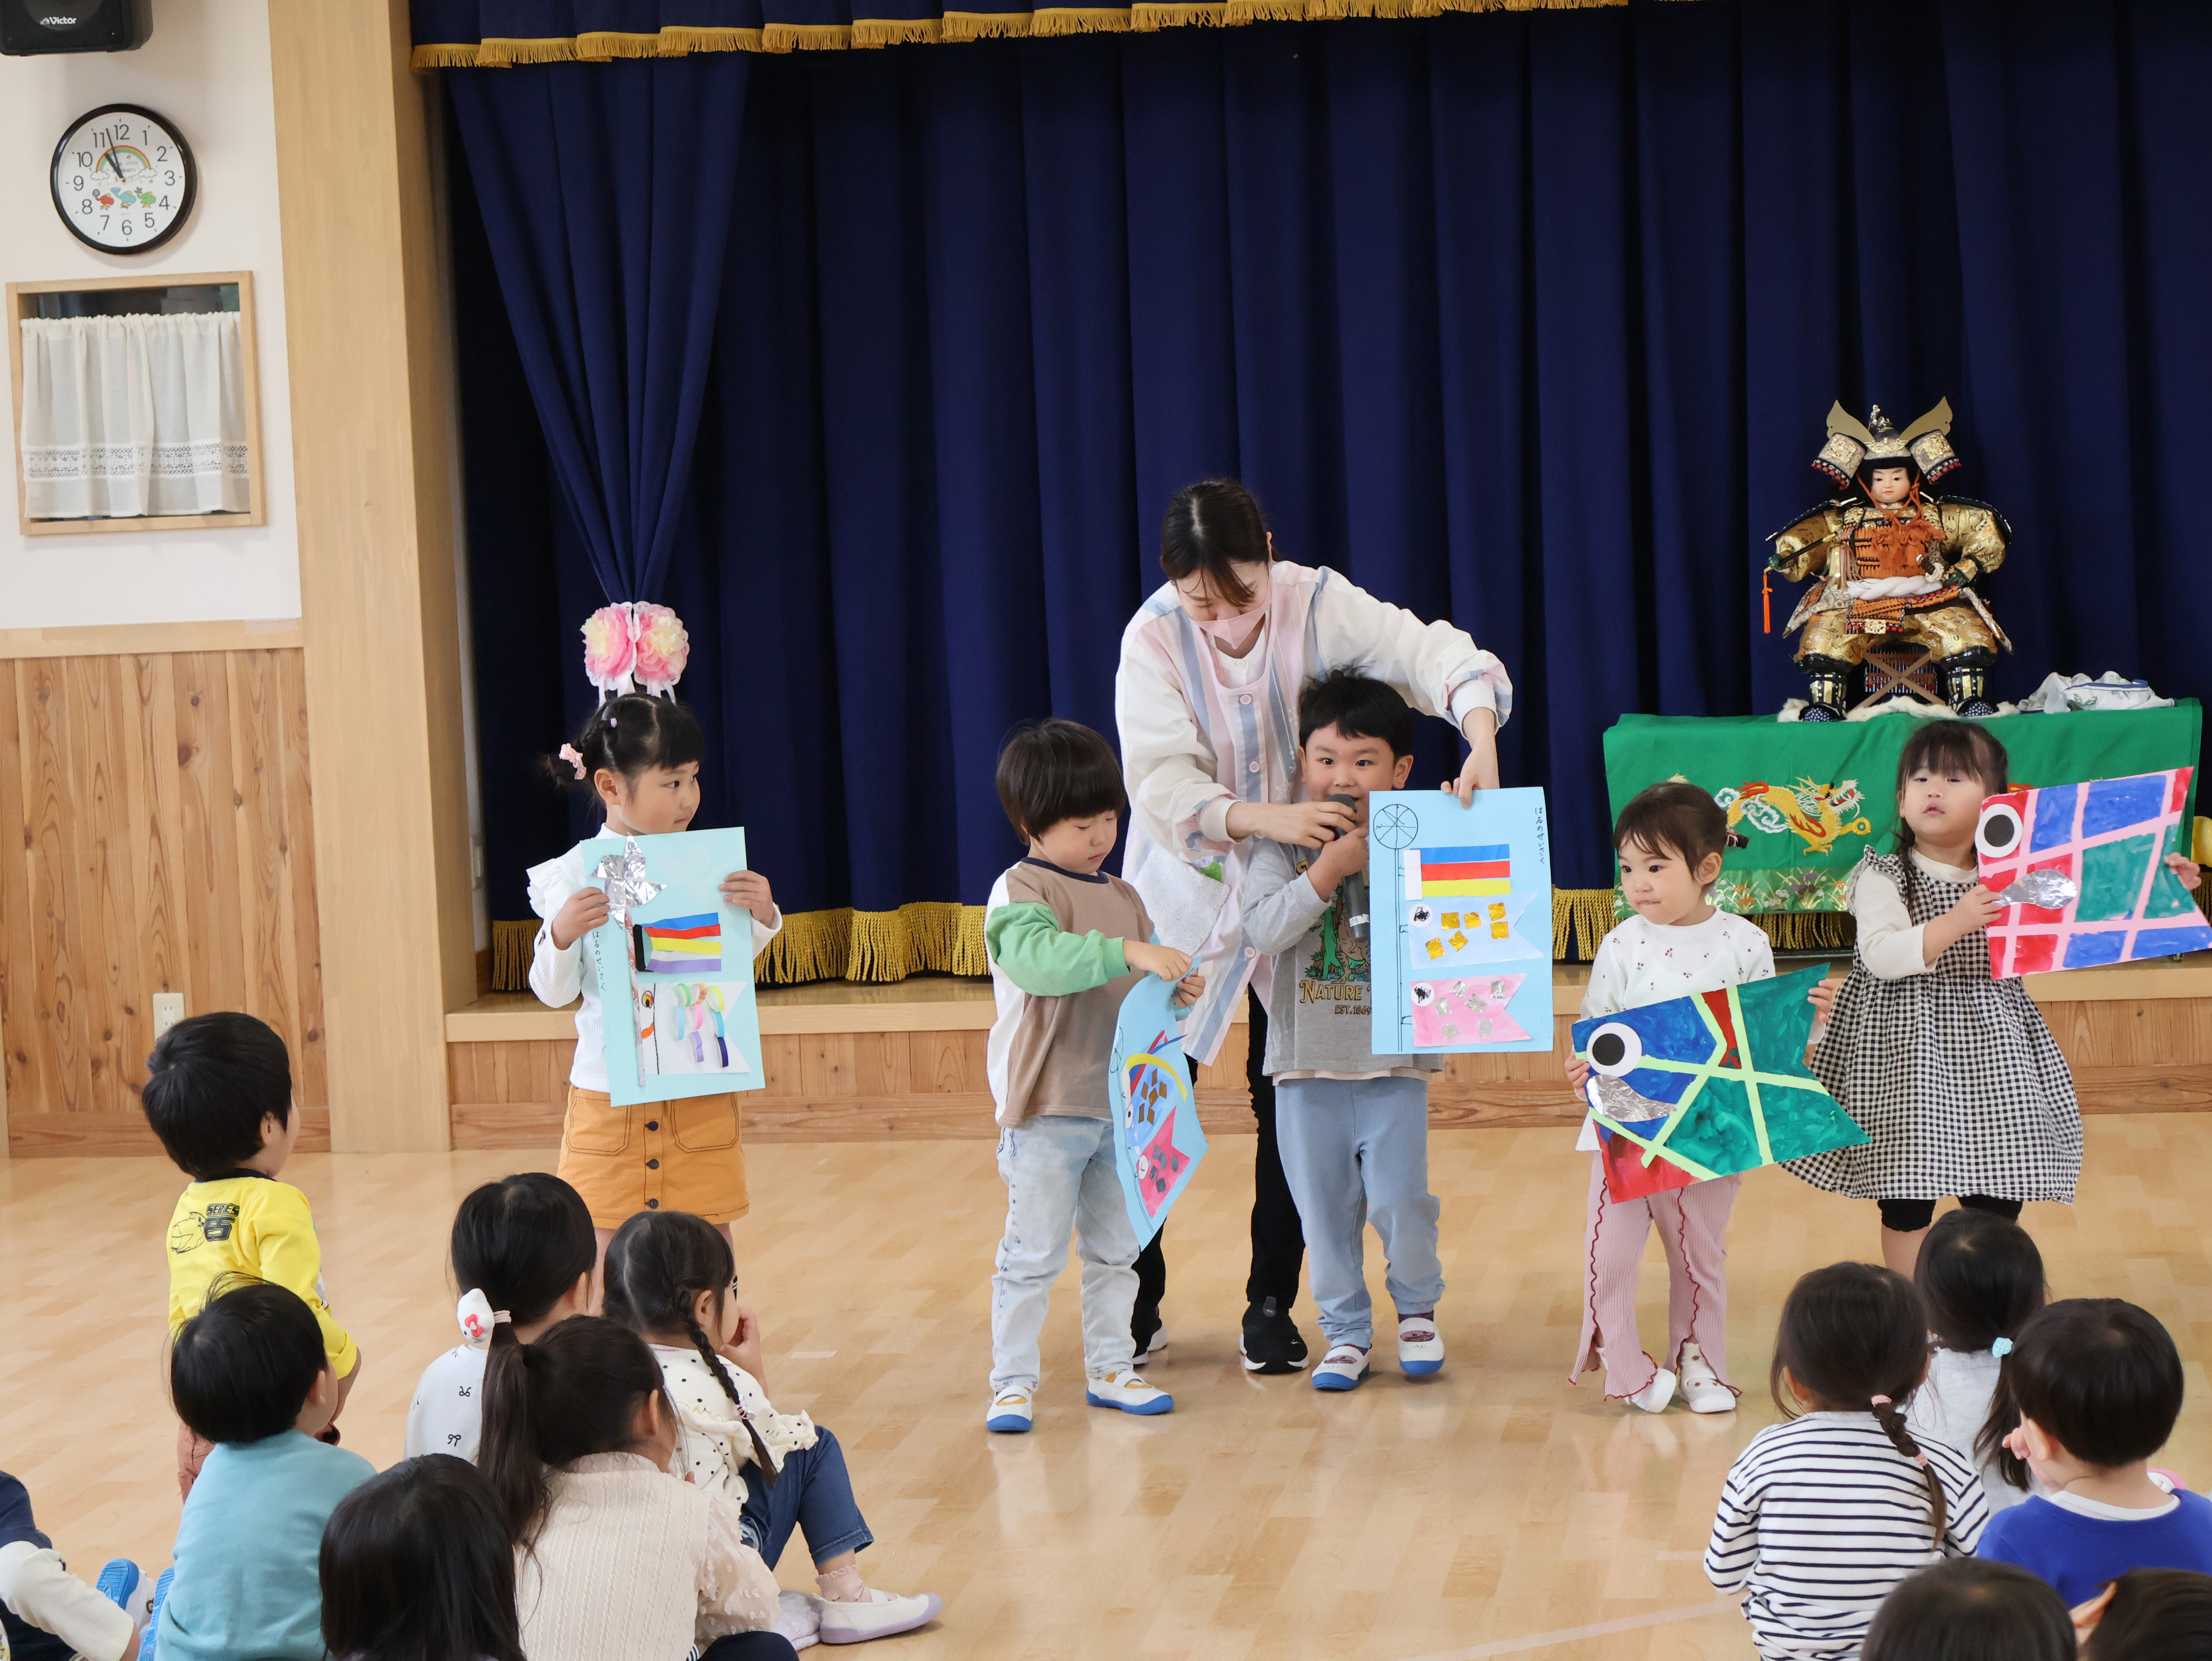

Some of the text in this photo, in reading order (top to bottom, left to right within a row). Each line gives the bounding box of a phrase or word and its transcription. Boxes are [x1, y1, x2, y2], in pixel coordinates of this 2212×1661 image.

[93, 132, 105, 148] 11
[114, 124, 130, 140] 12
[143, 130, 147, 146] 1
[77, 152, 93, 167] 10
[157, 146, 168, 162] 2
[74, 176, 84, 191] 9
[164, 171, 175, 186] 3
[82, 199, 93, 214] 8
[159, 195, 170, 211] 4
[100, 215, 110, 230] 7
[122, 220, 132, 235] 6
[145, 212, 155, 228] 5
[1535, 807, 1545, 865] はるのせいさく
[592, 931, 607, 991] はるのせいさく
[1299, 980, 1363, 1004] NATURE
[204, 1216, 235, 1242] E5
